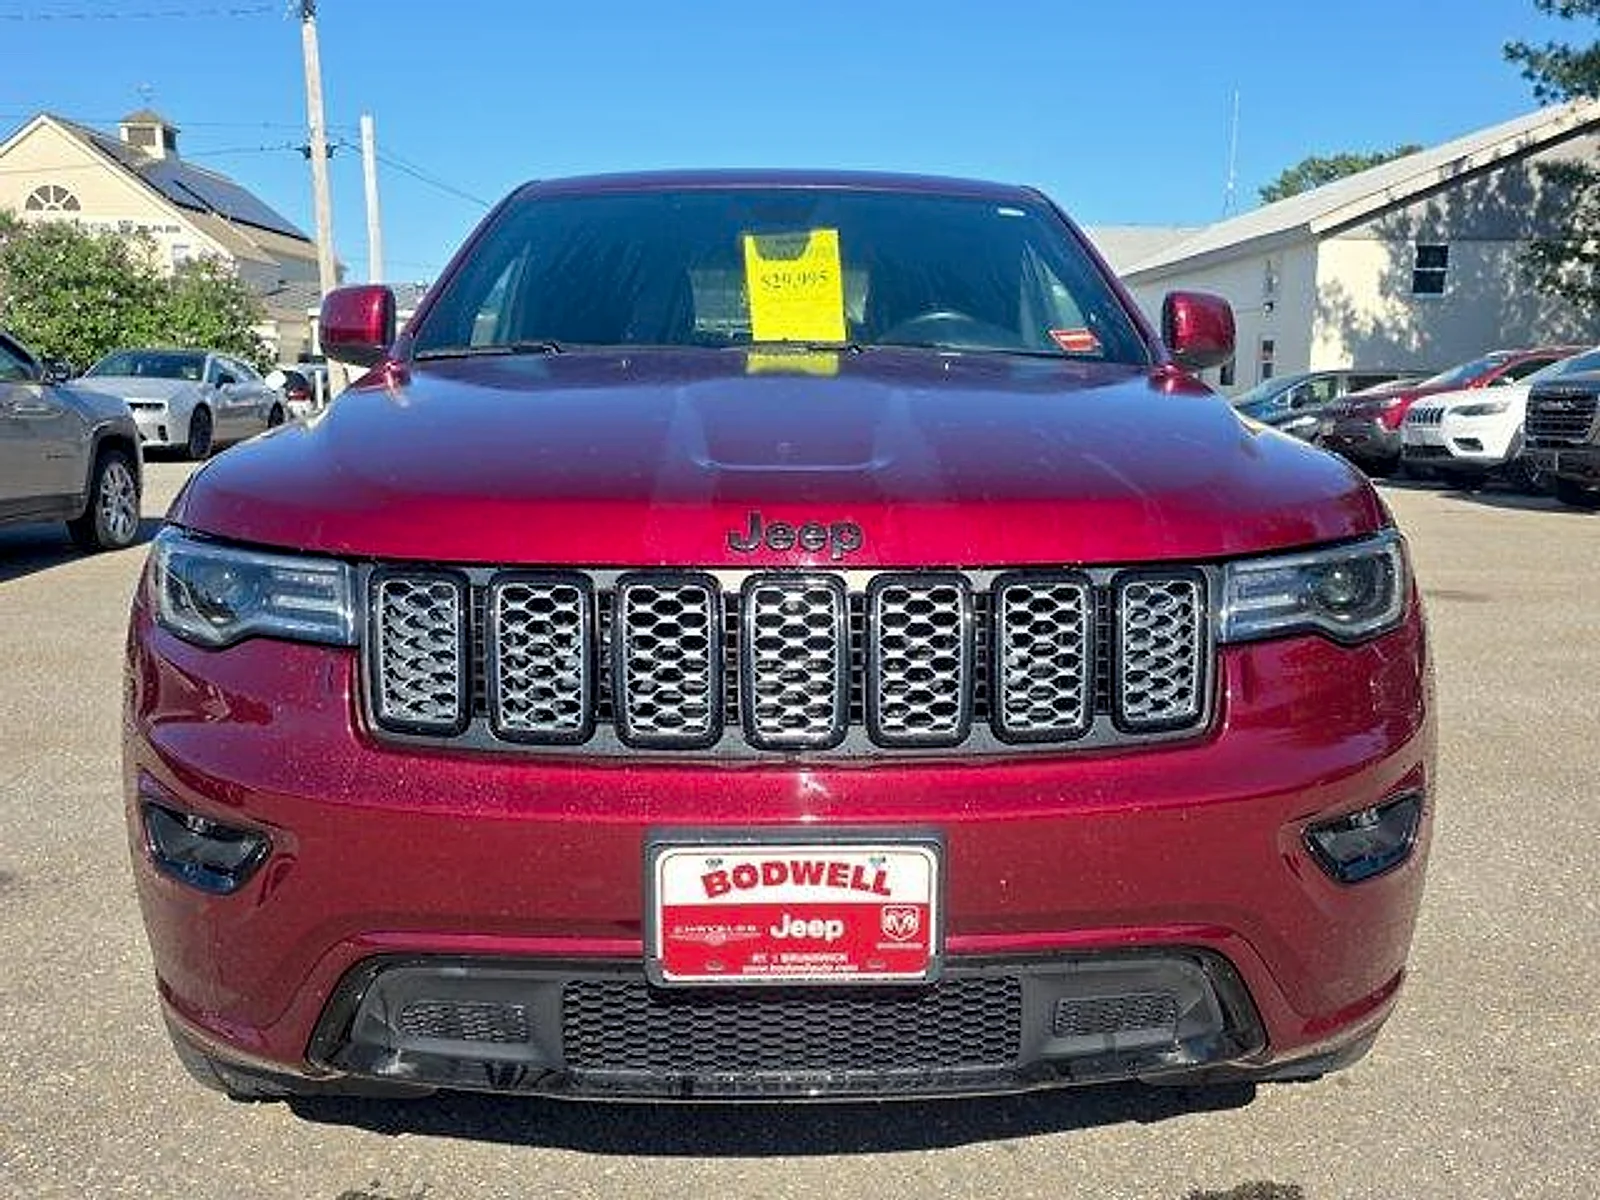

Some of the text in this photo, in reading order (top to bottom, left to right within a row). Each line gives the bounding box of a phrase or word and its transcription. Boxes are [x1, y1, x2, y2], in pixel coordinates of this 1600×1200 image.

[727, 510, 864, 560] Jeep
[701, 860, 891, 898] BODWELL
[770, 913, 844, 941] Jeep
